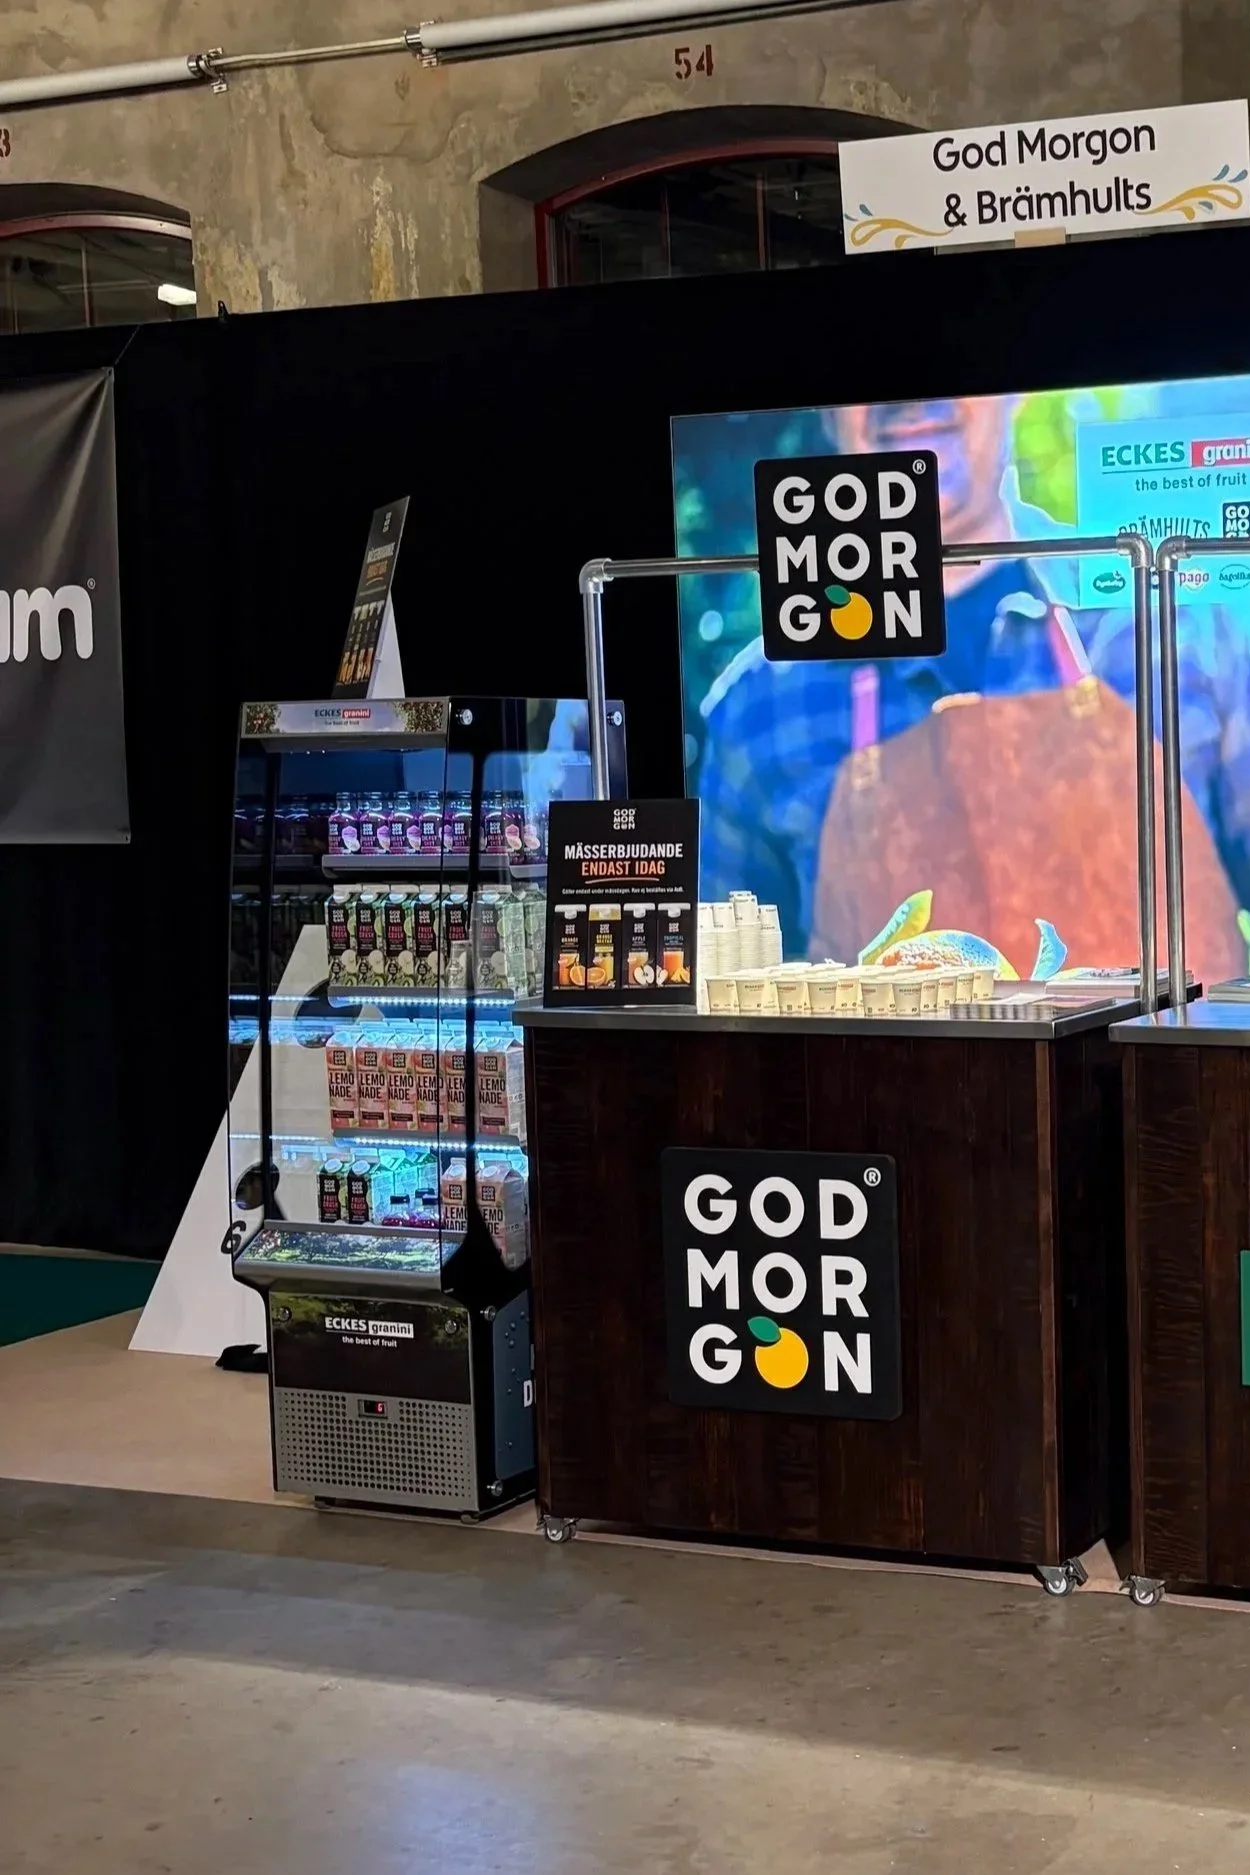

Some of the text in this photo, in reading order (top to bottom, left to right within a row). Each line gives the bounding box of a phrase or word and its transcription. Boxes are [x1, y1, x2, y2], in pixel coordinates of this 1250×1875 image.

[674, 44, 714, 80] 54
[932, 120, 1156, 172] God Morgon
[943, 176, 1152, 227] & Brämhults
[1101, 441, 1185, 467] ECKES
[1135, 472, 1248, 492] the best of fruit
[775, 530, 920, 585] MOR
[1179, 570, 1210, 588] pago
[314, 708, 341, 718] ECKES
[564, 842, 684, 860] MÄSSERBJUDANDE
[581, 860, 666, 876] ENDAST IDAG
[329, 1071, 355, 1085] LEMO
[360, 1073, 385, 1086] LEMO
[388, 1074, 414, 1088] LEMO
[480, 1078, 506, 1092] LEMO
[328, 1084, 352, 1098] NADE
[359, 1086, 382, 1099] NADE
[387, 1087, 411, 1101] NADE
[479, 1091, 503, 1105] NADE
[686, 1247, 870, 1319] MOR
[325, 1316, 411, 1336] ECKES granini
[342, 1336, 398, 1348] the best of fruit
